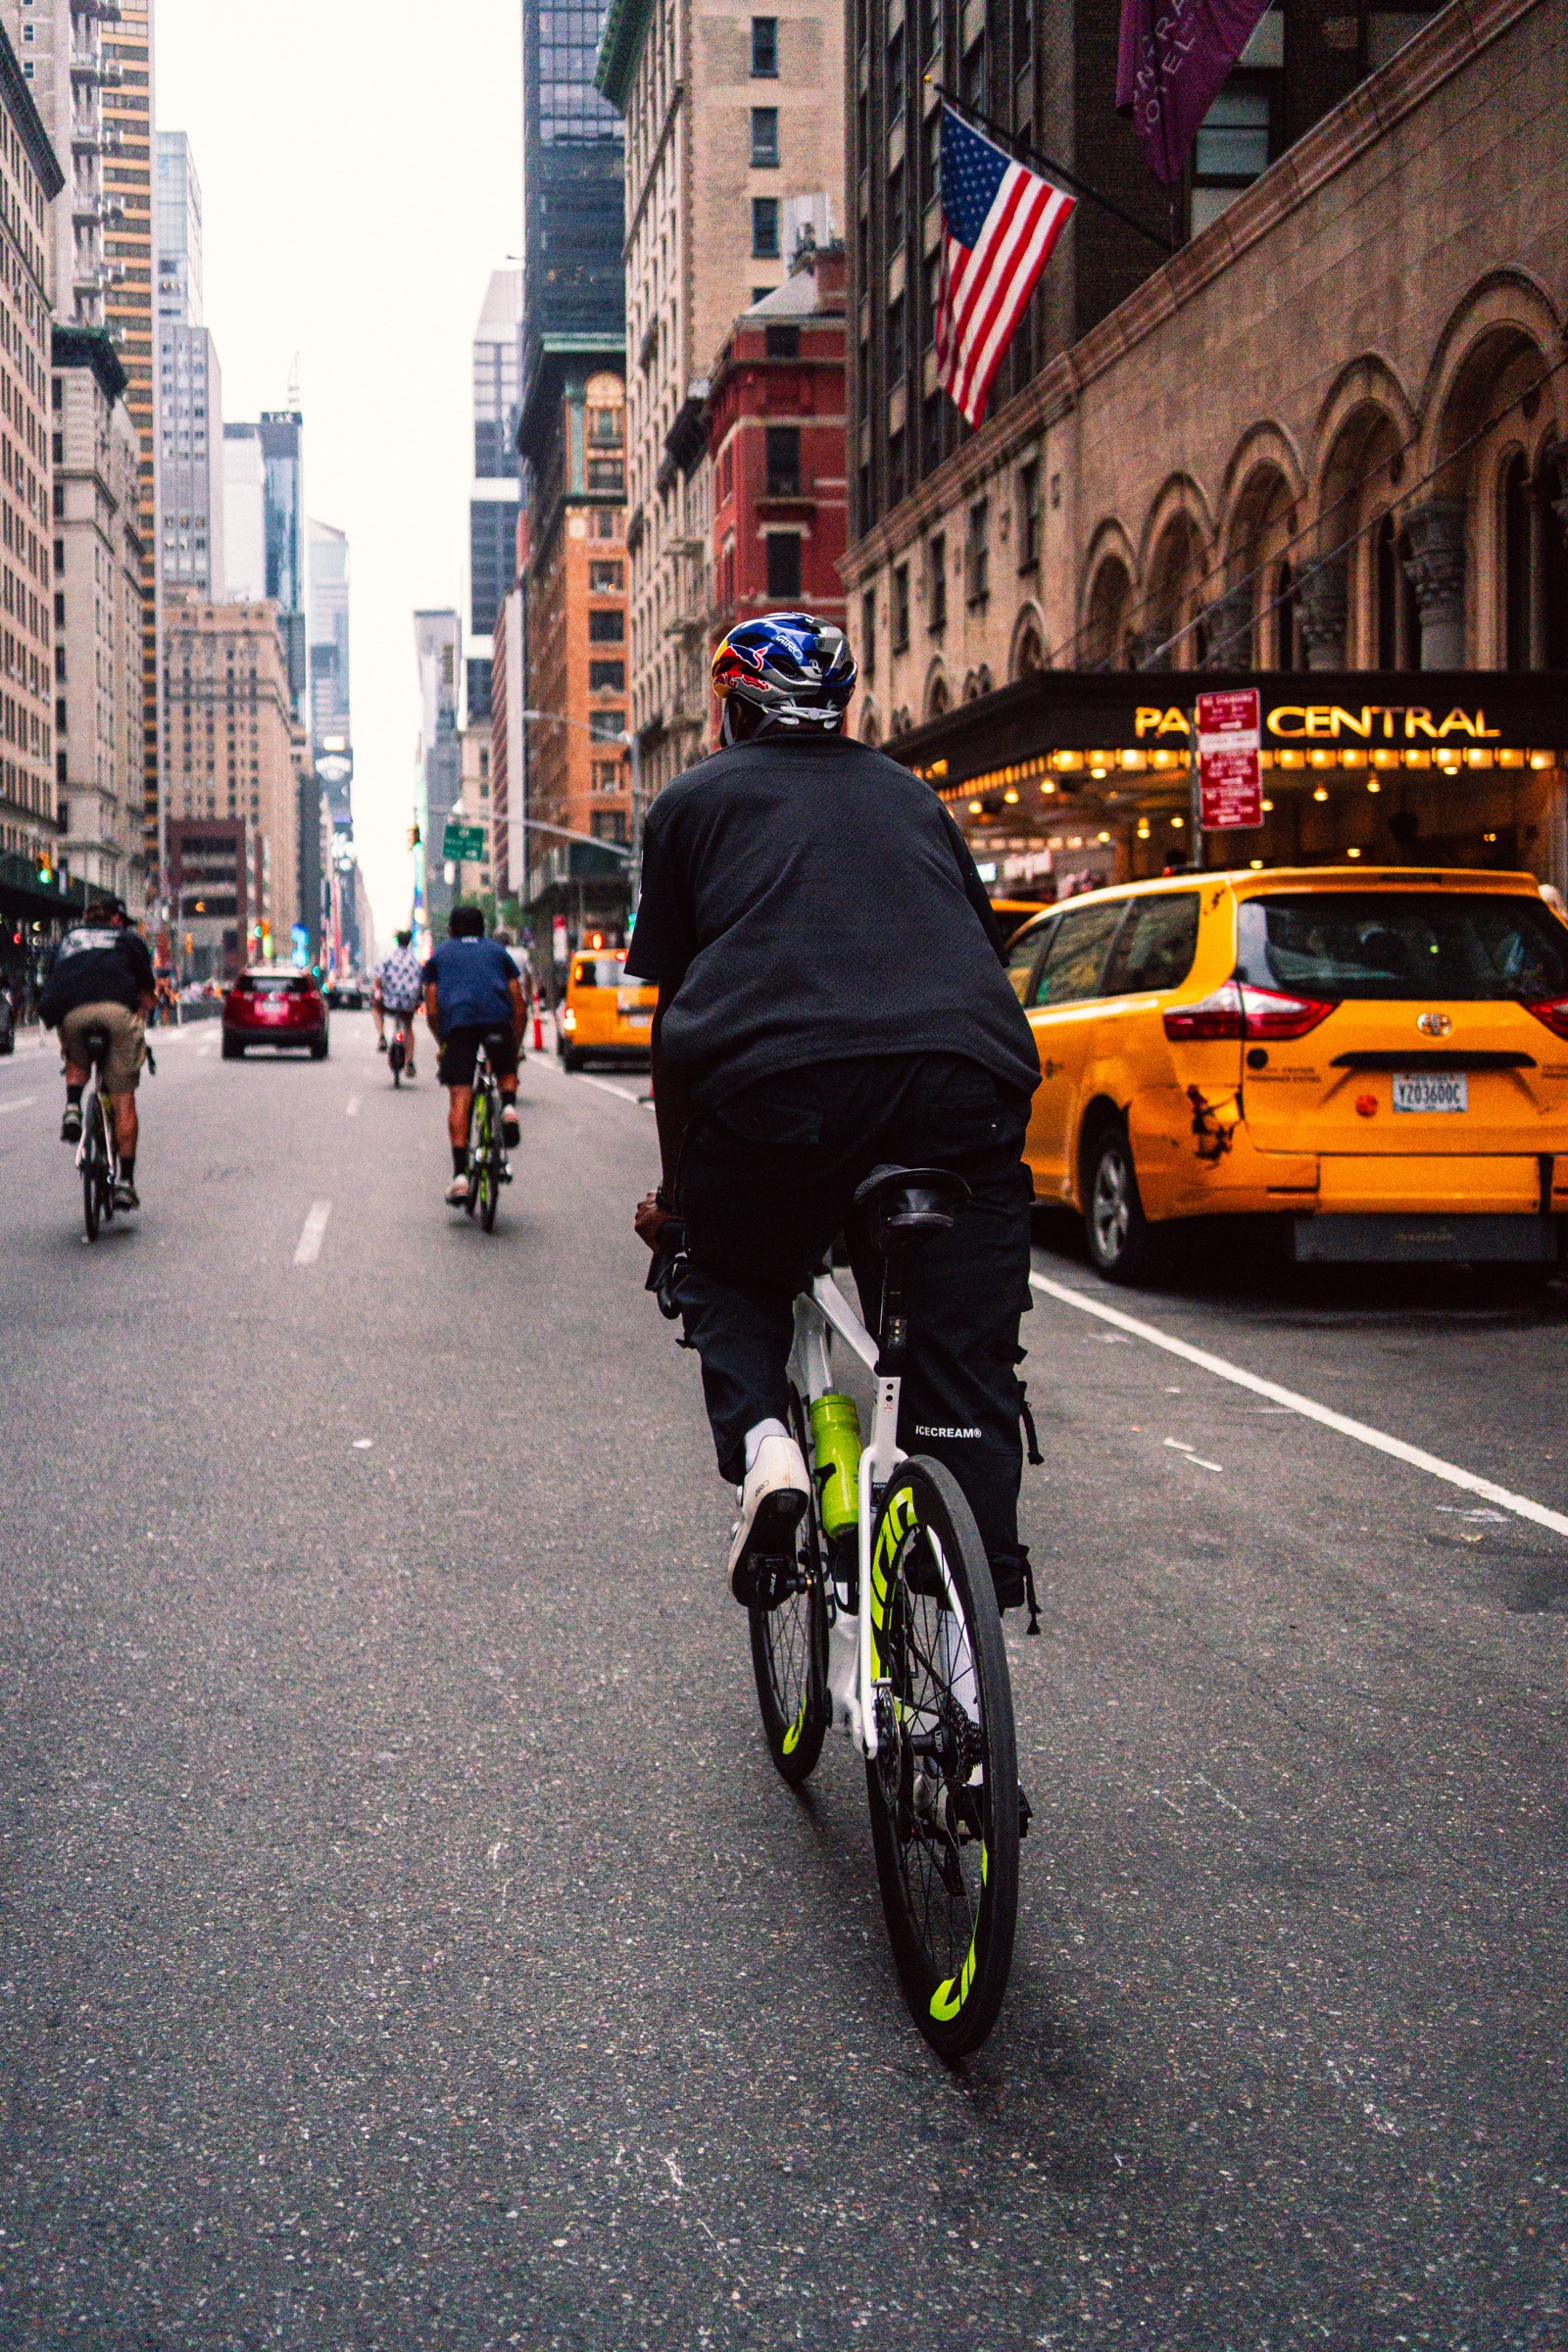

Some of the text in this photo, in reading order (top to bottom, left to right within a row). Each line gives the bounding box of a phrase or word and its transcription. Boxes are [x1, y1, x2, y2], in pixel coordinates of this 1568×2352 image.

[775, 634, 804, 661] GIRO
[1135, 705, 1501, 739] PA CENTRAL
